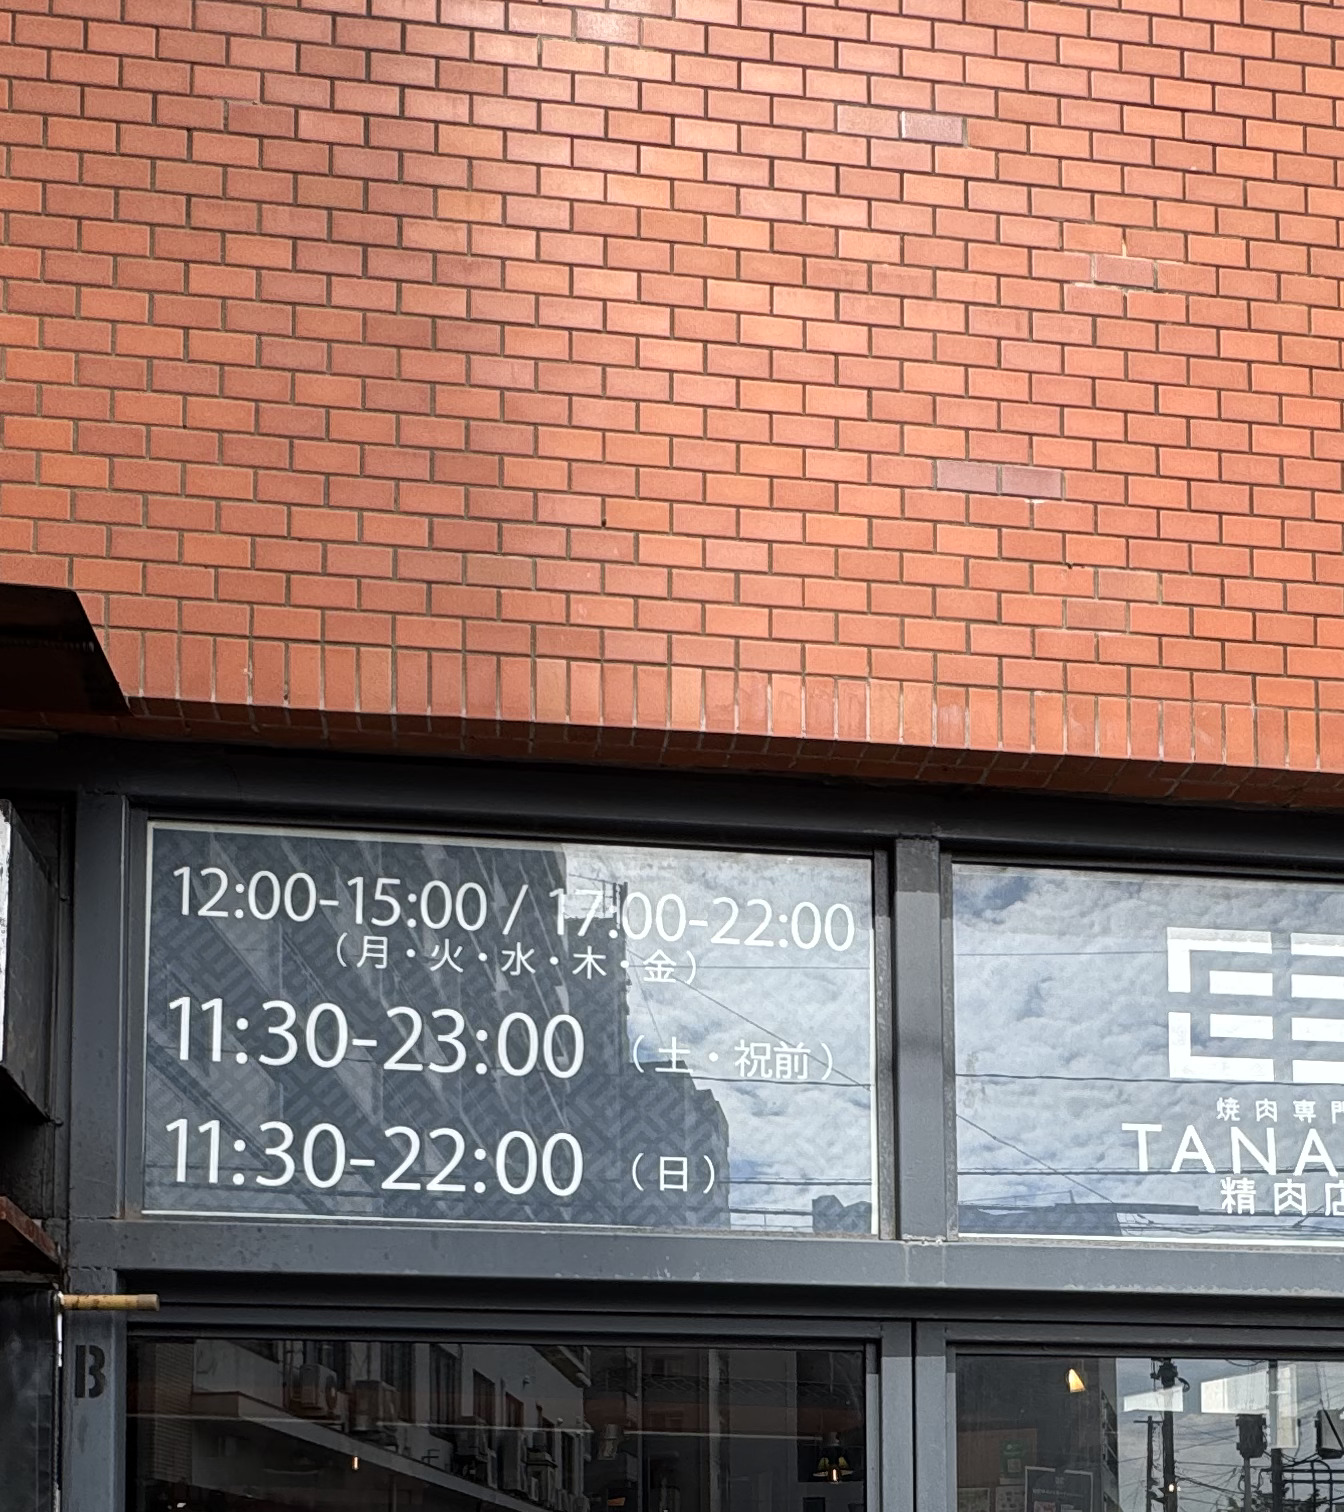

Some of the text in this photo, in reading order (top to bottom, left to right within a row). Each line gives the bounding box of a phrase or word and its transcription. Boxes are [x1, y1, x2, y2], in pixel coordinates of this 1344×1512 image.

[172, 866, 487, 931] 12:00-15:00
[168, 996, 586, 1079] 11:30-23:00
[165, 1117, 584, 1197] 11:30-22:00
[74, 1344, 106, 1398] B
